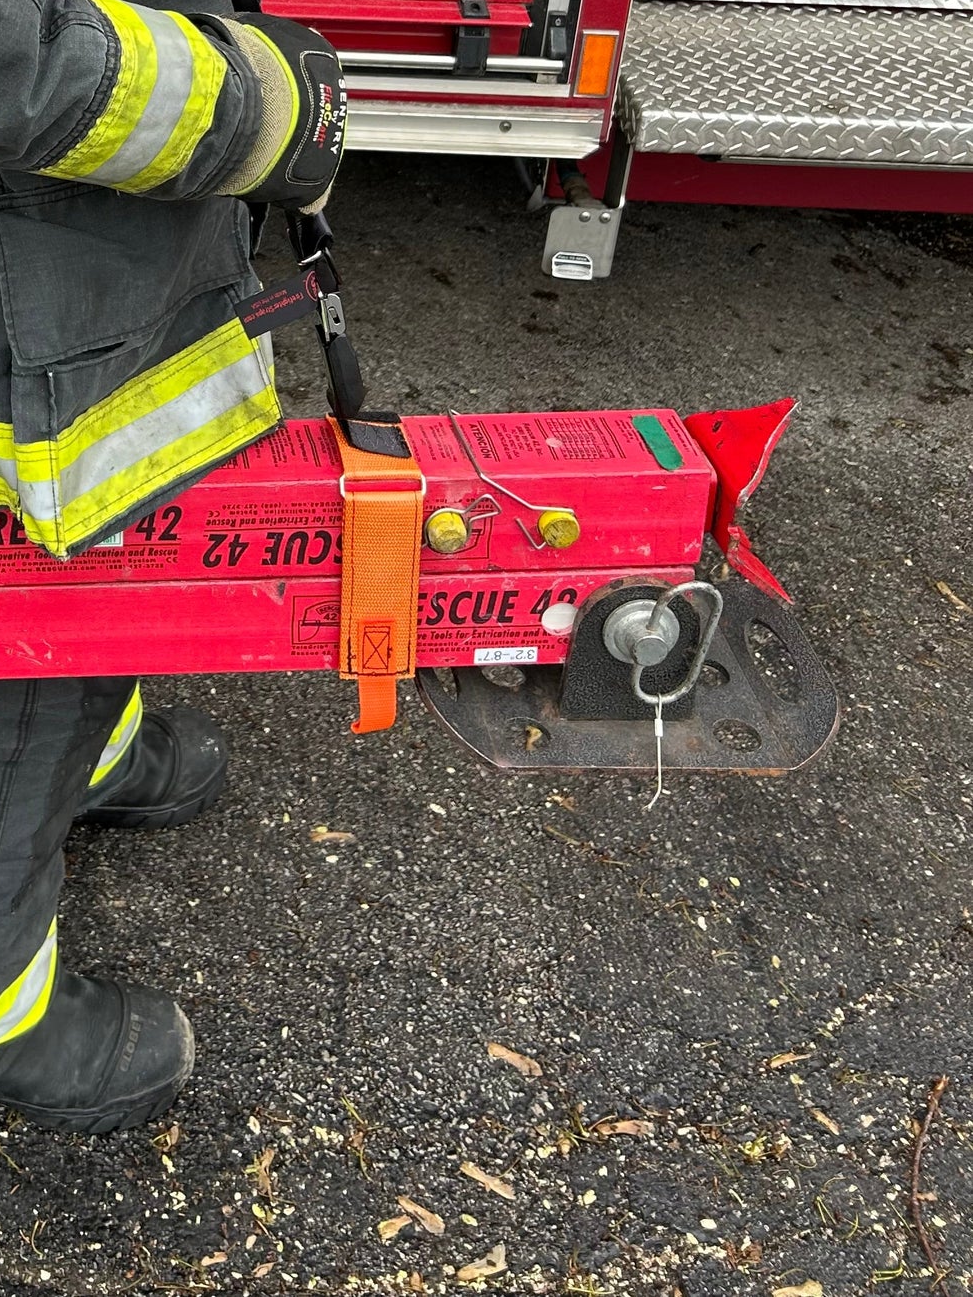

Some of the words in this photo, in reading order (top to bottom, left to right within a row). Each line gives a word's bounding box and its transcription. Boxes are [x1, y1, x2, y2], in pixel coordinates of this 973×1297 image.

[329, 78, 347, 155] SENTRY
[331, 110, 340, 123] by
[136, 506, 183, 542] 42
[205, 518, 237, 527] Rescue
[240, 517, 256, 527] and
[260, 517, 309, 526] Extrication
[311, 516, 325, 525] for
[128, 547, 145, 557] and
[147, 547, 178, 556] Rescue
[202, 533, 250, 568] 42
[417, 590, 520, 626] ESCUE
[323, 612, 338, 621] 42
[430, 630, 453, 640] Tools
[455, 629, 468, 639] for
[472, 628, 521, 638] Extrication
[523, 629, 539, 637] and
[120, 1016, 141, 1072] GLOBE
